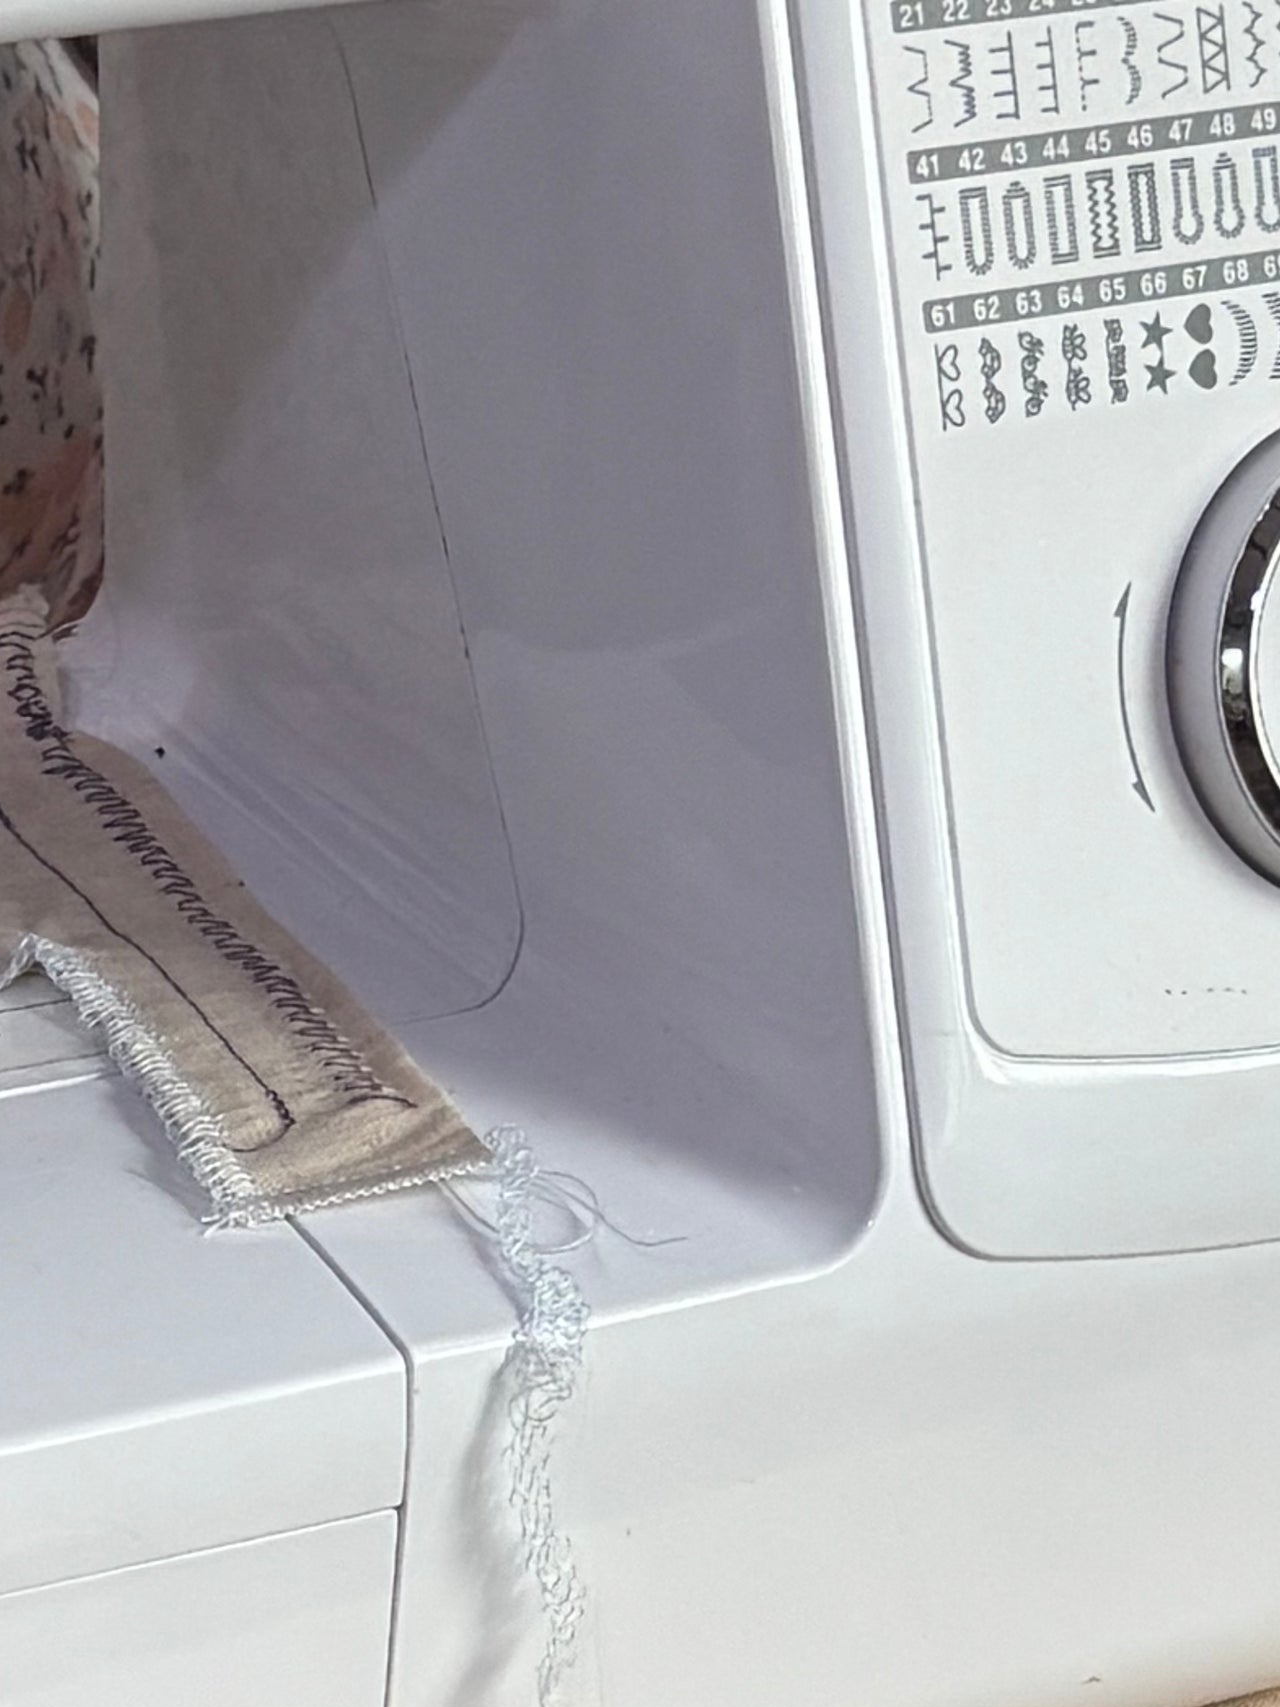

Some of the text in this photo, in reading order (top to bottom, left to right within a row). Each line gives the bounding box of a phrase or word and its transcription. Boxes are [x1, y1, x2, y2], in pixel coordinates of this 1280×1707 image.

[899, 4, 925, 28] 21
[942, 0, 970, 22] 22
[915, 153, 940, 178] 41
[957, 147, 986, 172] 42
[999, 140, 1028, 166] 43
[1041, 134, 1070, 160] 44
[1083, 129, 1112, 155] 45
[1126, 124, 1154, 149] 46
[1167, 117, 1193, 142] 47
[1208, 112, 1236, 137] 48
[1249, 107, 1277, 131] 49
[930, 301, 956, 328] 61
[972, 294, 1001, 321] 62
[1014, 289, 1043, 316] 63
[1056, 283, 1085, 309] 64
[1098, 276, 1126, 303] 65
[1139, 271, 1167, 297] 66
[1181, 264, 1208, 290] 67
[1222, 258, 1250, 285] 68
